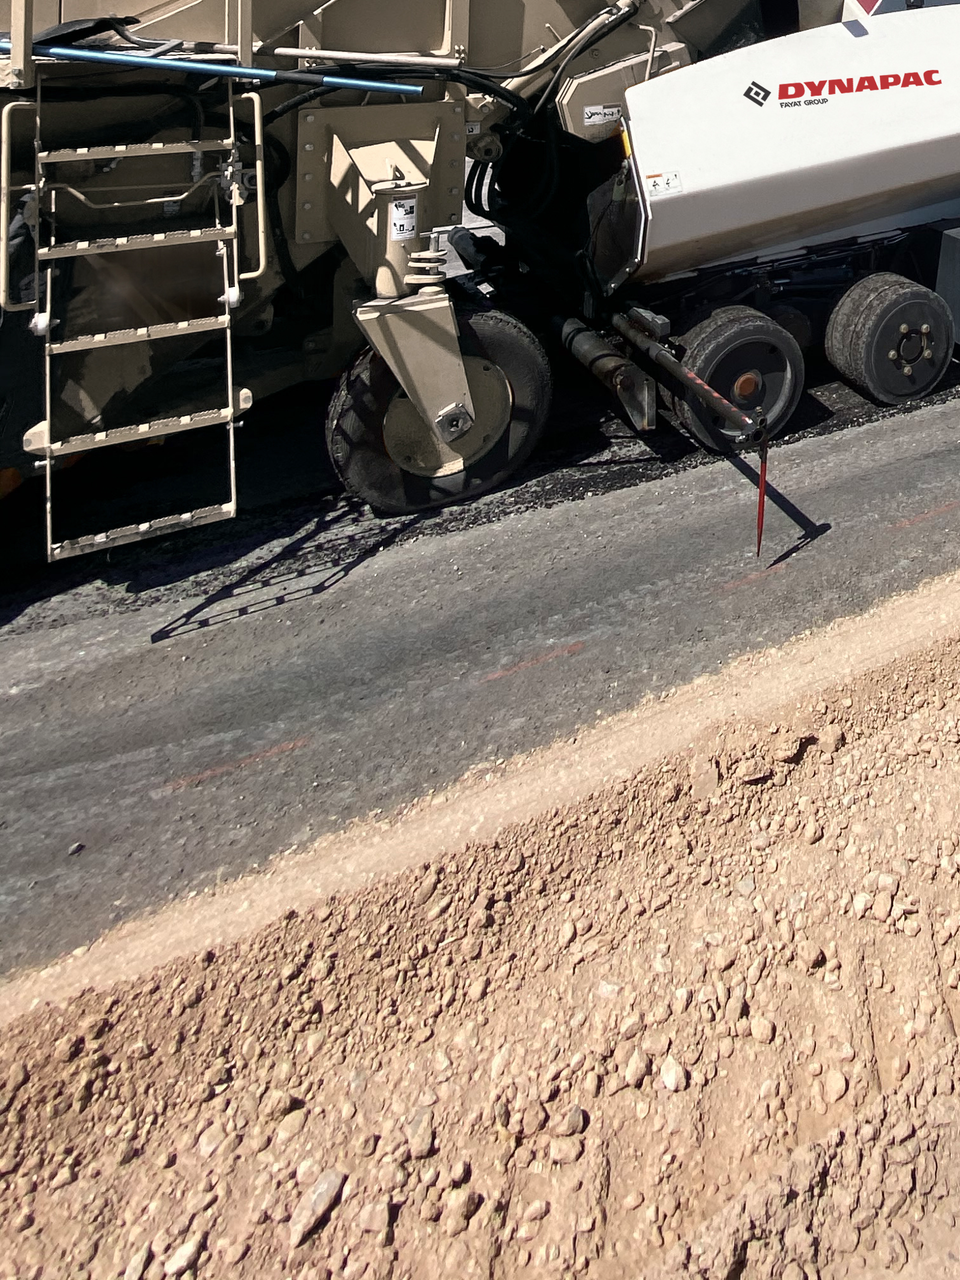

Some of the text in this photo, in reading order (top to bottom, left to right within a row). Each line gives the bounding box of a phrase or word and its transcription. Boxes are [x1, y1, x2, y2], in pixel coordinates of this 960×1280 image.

[778, 70, 942, 100] DYNAPAC
[780, 98, 829, 109] FAYAT GROUP
